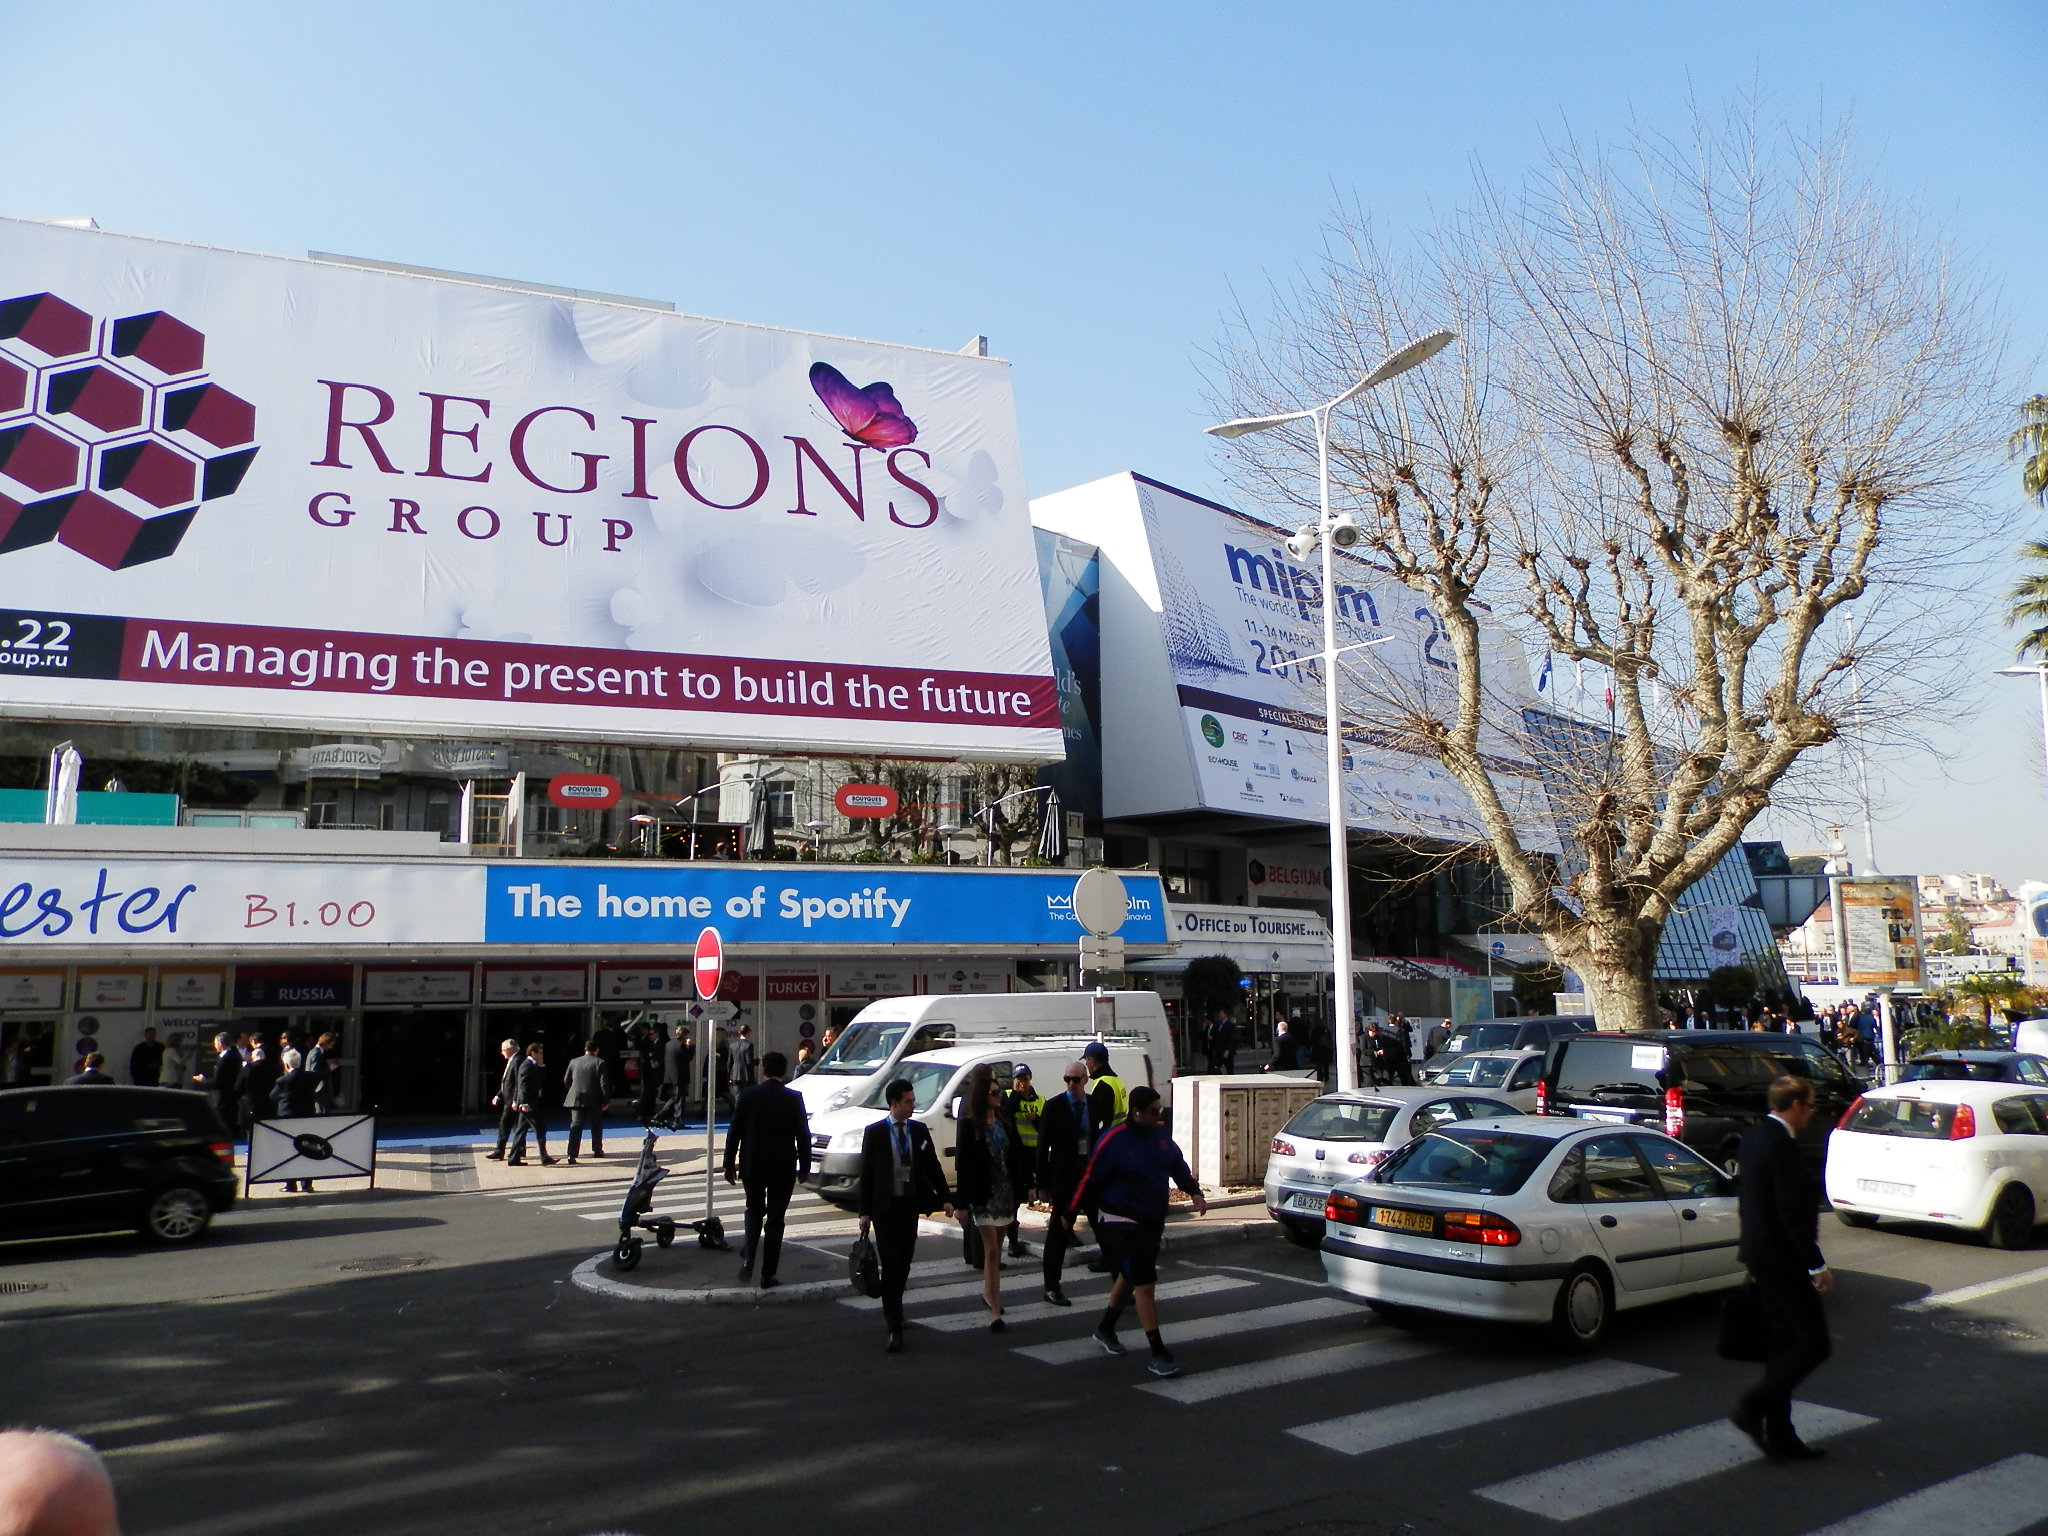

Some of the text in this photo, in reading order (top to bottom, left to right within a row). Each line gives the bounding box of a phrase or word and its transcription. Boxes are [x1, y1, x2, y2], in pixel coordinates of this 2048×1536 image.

[310, 379, 940, 528] REGIONS
[308, 491, 635, 552] GROUP
[1224, 543, 1380, 627] mipm
[1235, 586, 1257, 607] The
[1259, 597, 1297, 618] world's
[1279, 630, 1316, 649] MARCH
[140, 630, 1031, 716] Managing the present to build the future
[1269, 865, 1321, 885] BELGIUM
[244, 894, 376, 929] B1.00
[508, 883, 912, 928] The home of Spotify
[1049, 911, 1065, 921] The
[279, 988, 335, 1001] RUSSIA
[767, 982, 818, 994] TURKEY
[1380, 1209, 1403, 1225] 1744
